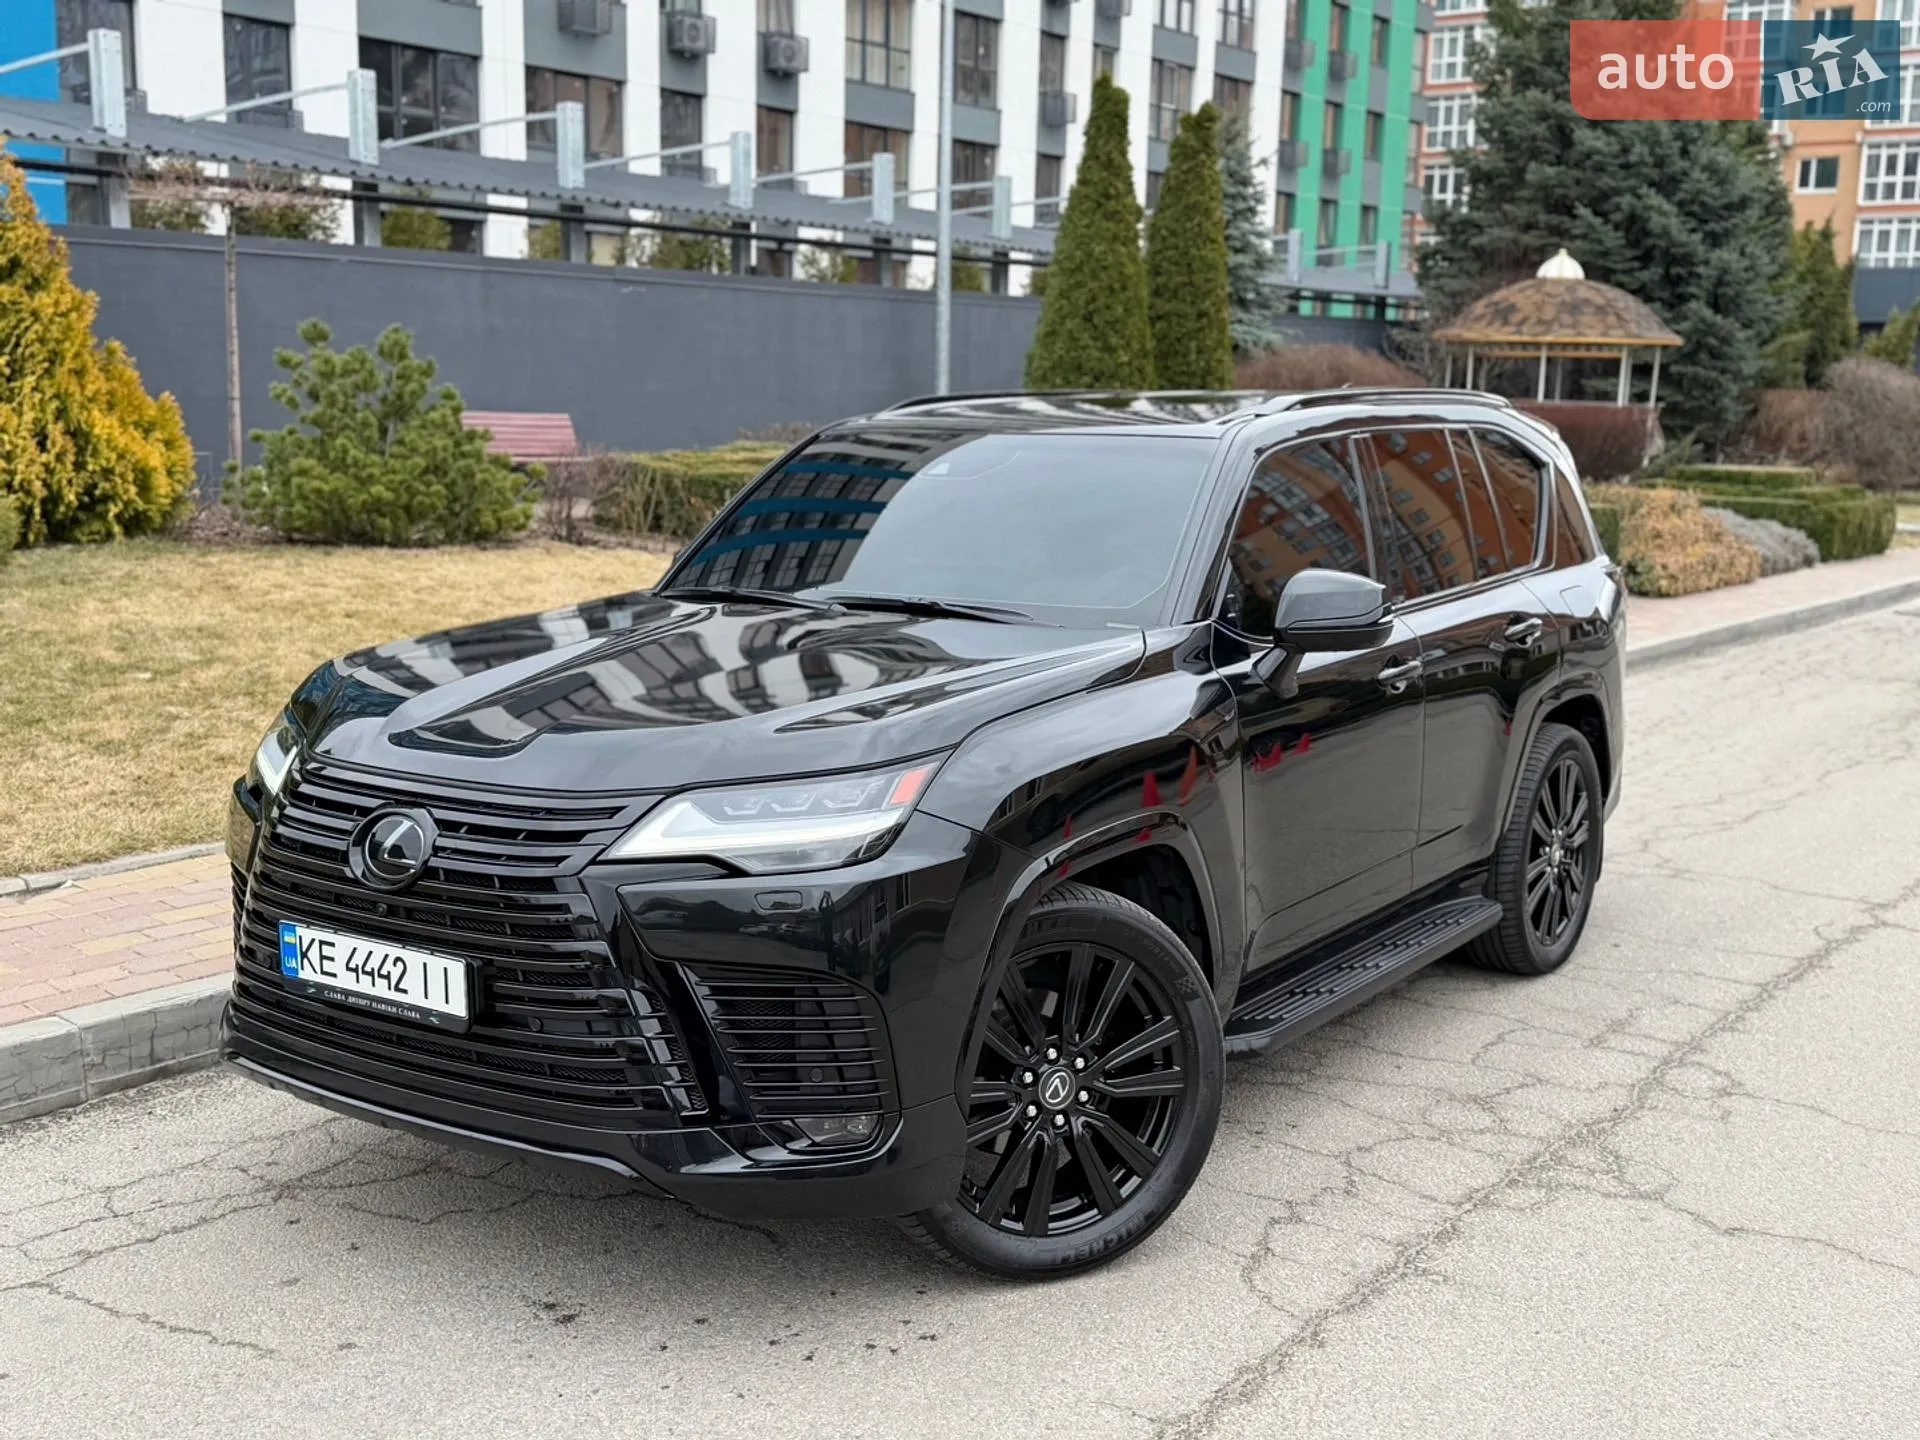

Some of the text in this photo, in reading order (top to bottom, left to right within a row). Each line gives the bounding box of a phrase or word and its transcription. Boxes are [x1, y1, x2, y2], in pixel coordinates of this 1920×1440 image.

[285, 955, 297, 969] UA
[299, 935, 338, 979] KE
[345, 947, 409, 995] 4442
